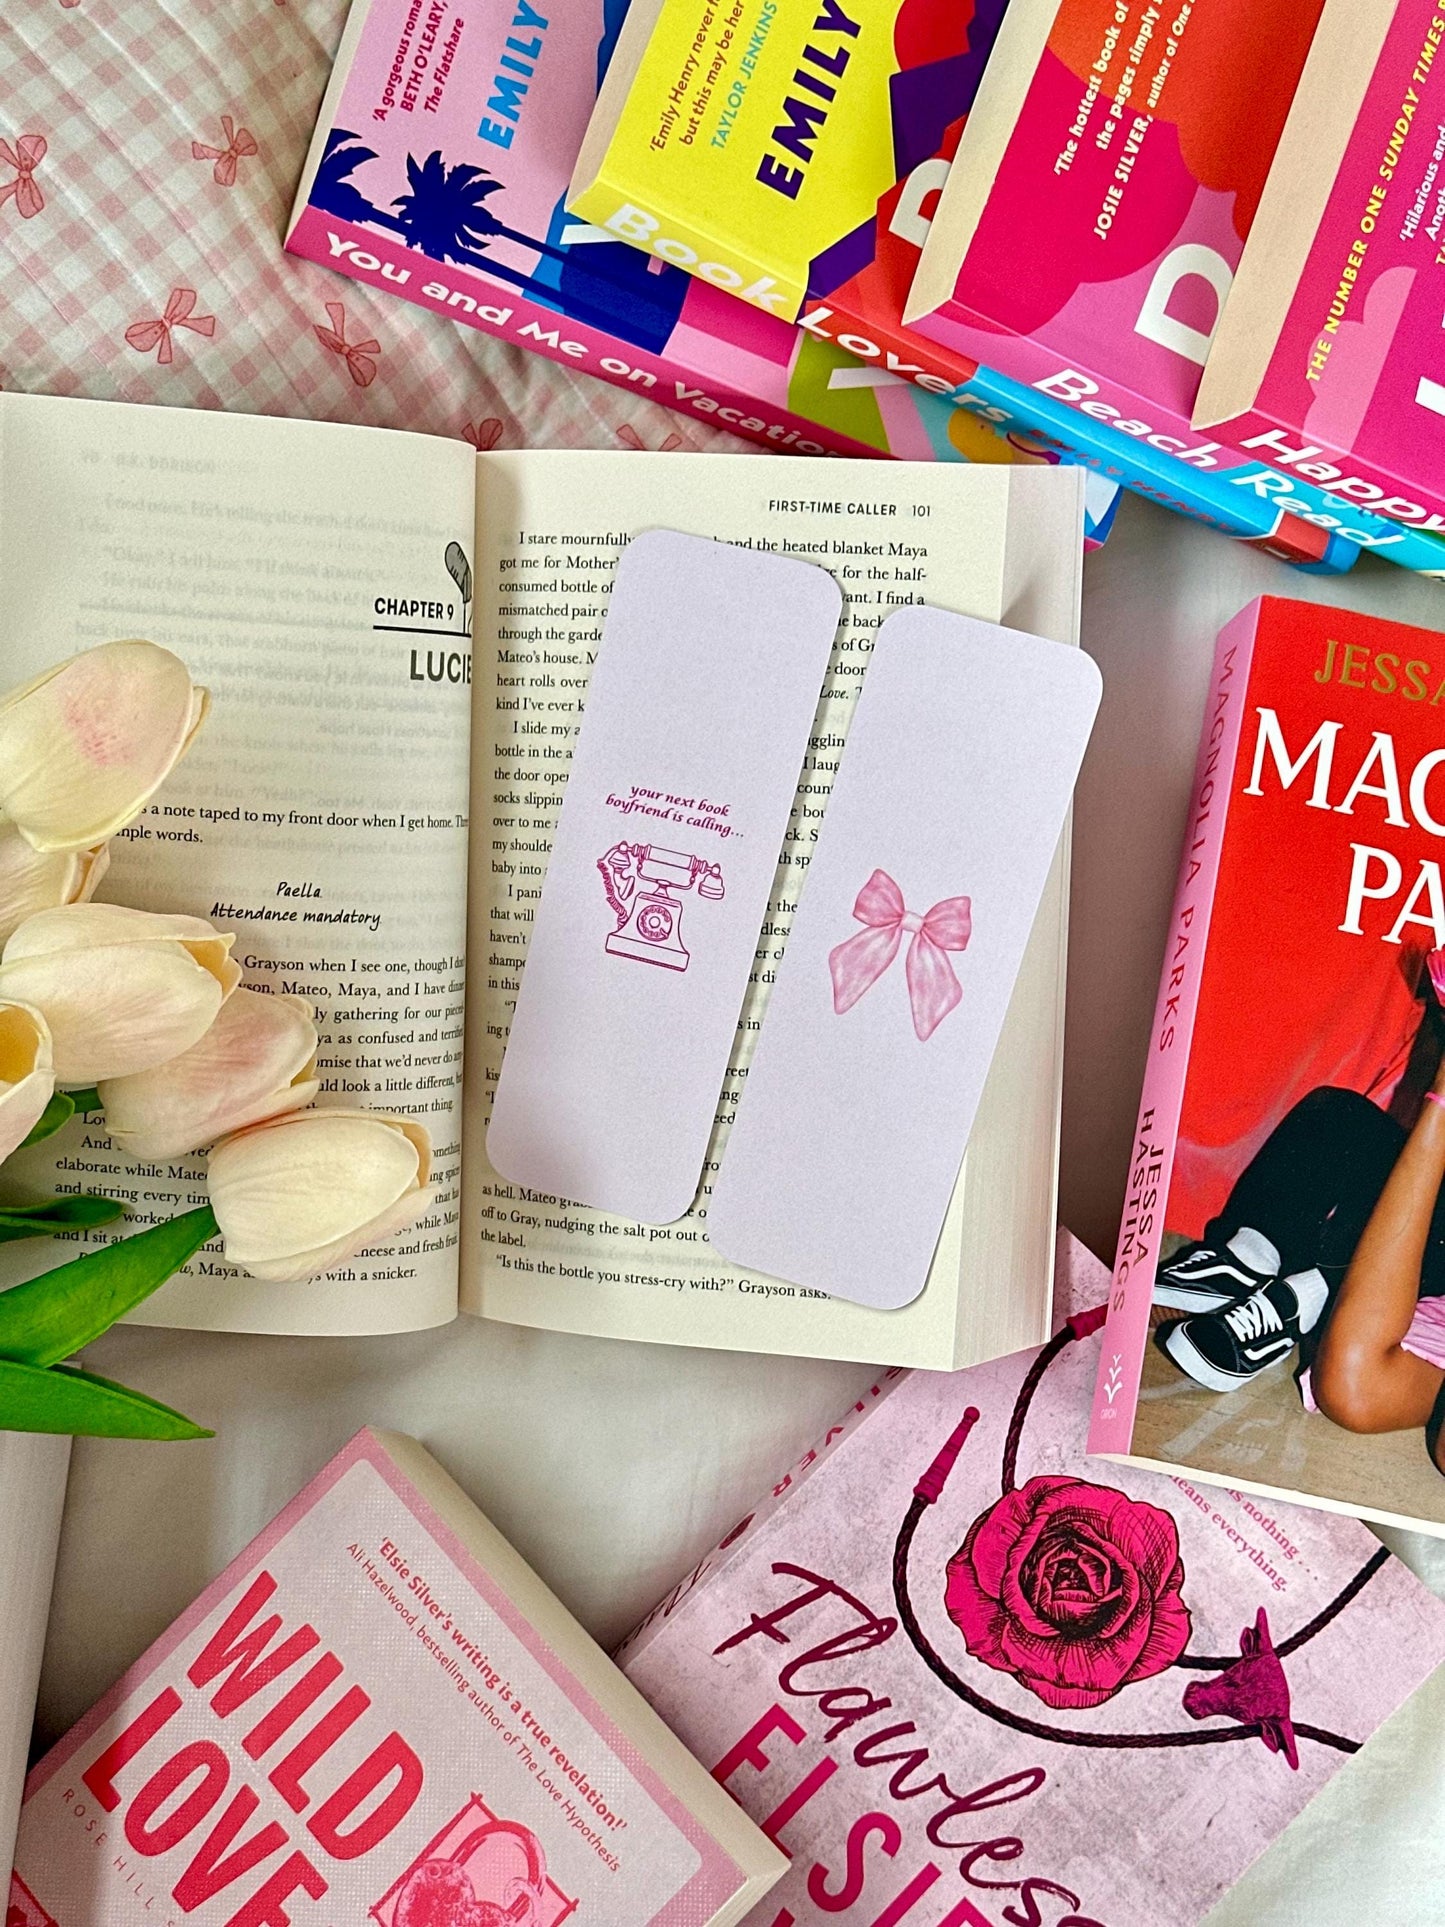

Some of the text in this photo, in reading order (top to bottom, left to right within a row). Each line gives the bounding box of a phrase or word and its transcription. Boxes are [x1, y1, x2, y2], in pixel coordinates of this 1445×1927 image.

[724, 0, 745, 28] her
[400, 1, 449, 112] BETH O’LEARY,
[668, 54, 700, 104] Henry
[692, 8, 719, 53] never
[715, 30, 734, 50] be
[382, 38, 410, 108] gorgeous
[424, 18, 464, 114] The Flatshare
[477, 0, 549, 150] EMILY
[707, 52, 728, 86] may
[710, 1, 777, 149] TAYLOR JENKINS
[1069, 75, 1102, 138] hottest
[1092, 25, 1121, 73] book
[1114, 0, 1130, 24] of
[1096, 5, 1161, 151] the pages simply
[693, 86, 712, 116] this
[755, 0, 861, 200] EMILY
[1093, 3, 1192, 240] JOSIE SILVER, author of One
[679, 117, 700, 146] but
[1306, 15, 1445, 382] THE NUMBER ONE SUNDAY TIMES
[602, 203, 791, 312] Book
[326, 231, 411, 285] You
[421, 281, 514, 328] and
[516, 320, 590, 361] Me
[599, 355, 658, 388] on
[796, 306, 1014, 423] Lovers
[1032, 368, 1221, 470] Beach
[1239, 429, 1445, 531] Happy
[769, 499, 931, 517] FIRST-TIME CALLER 101
[1230, 470, 1406, 548] Read
[528, 534, 557, 545] stare
[757, 538, 928, 560] the heated blanket Maya
[500, 556, 561, 572] got for
[499, 579, 615, 594] consumed bottle of
[374, 598, 454, 620] CHAPTER 9
[498, 603, 599, 620] mismatched pair
[497, 649, 583, 664] Mateo’s house.
[498, 627, 542, 643] through
[410, 650, 472, 684] LUCIE
[497, 674, 555, 688] heart rolls
[1184, 646, 1239, 886] MAGNOLIA
[164, 804, 424, 832] note taped to my front door when get
[605, 794, 745, 838] boyfriend is calling...
[629, 785, 731, 817] your next book
[210, 902, 298, 922] Attendance
[244, 955, 448, 975] Grayson when see one, though
[1159, 904, 1196, 1052] PARKS
[334, 1006, 399, 1023] gathering
[56, 1157, 163, 1178] elaborate while
[86, 1183, 182, 1206] stirring every
[1113, 1107, 1156, 1313] HASTINGS
[1132, 1146, 1164, 1267] JESSA
[498, 1231, 526, 1248] label.
[510, 1211, 698, 1241] Gray, nudging the salt pot out
[372, 1266, 417, 1280] snicker.
[514, 1258, 534, 1272] this
[537, 1261, 556, 1275] the
[559, 1262, 594, 1280] bottle
[598, 1270, 621, 1284] you
[624, 1273, 685, 1293] stress-cry
[738, 1280, 795, 1298] Grayson
[1212, 1513, 1288, 1592] everything.
[346, 1543, 621, 1872] Ali Hazelwood, bestselling author of The Love Hypothesis
[452, 1628, 502, 1690] writing
[499, 1682, 513, 1702] is
[510, 1700, 522, 1715] a
[520, 1710, 552, 1749] true
[187, 1569, 424, 1861] WILD
[81, 1685, 329, 1927] LOVE
[62, 1787, 155, 1910] ROSE HILL
